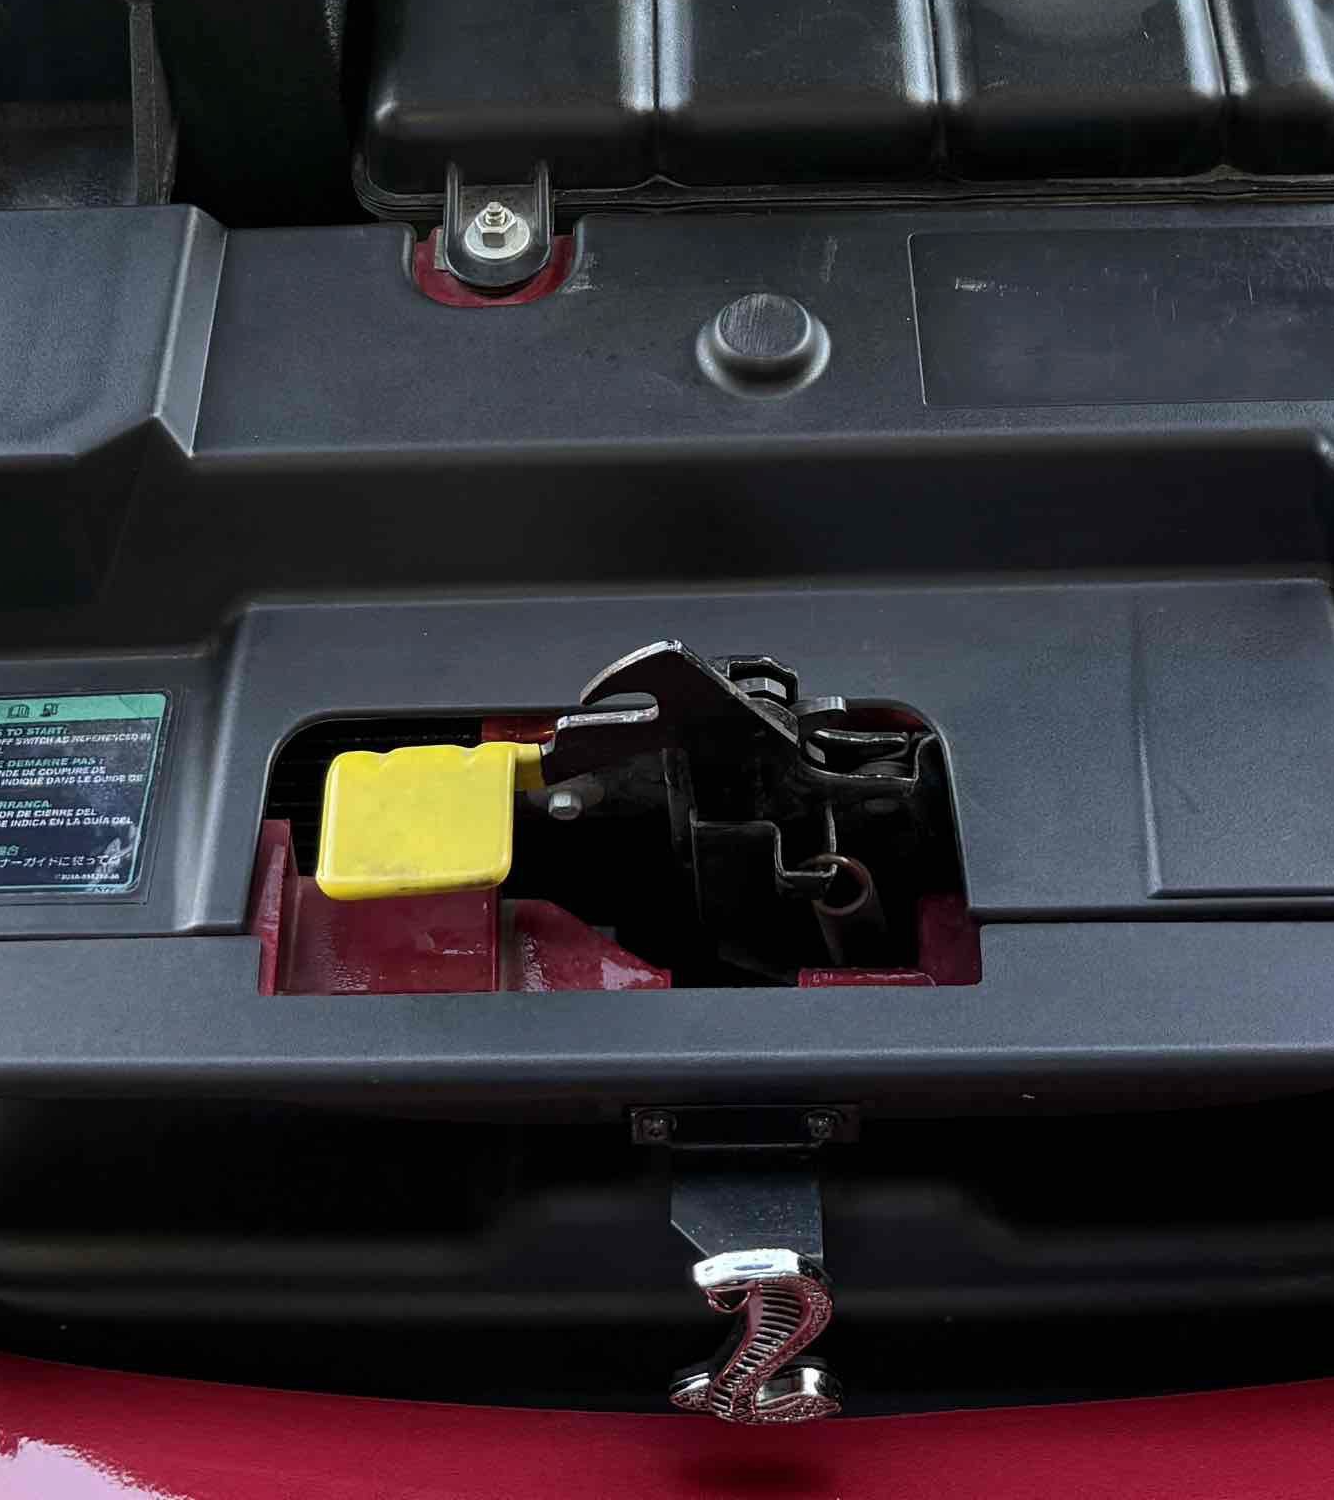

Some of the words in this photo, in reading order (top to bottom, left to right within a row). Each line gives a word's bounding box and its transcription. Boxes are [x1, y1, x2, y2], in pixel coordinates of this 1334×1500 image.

[7, 726, 22, 737] TO
[15, 736, 53, 746] SWITCH
[54, 736, 69, 744] AS
[22, 769, 36, 778] DE
[38, 767, 89, 777] COUPURE
[90, 766, 106, 775] DE
[47, 776, 76, 786] DANS
[77, 775, 91, 784] LE
[92, 774, 125, 784] GUIDE
[16, 810, 31, 819] DE
[34, 808, 73, 818] CIERRE
[76, 807, 96, 816] DEL
[10, 818, 47, 828] INDICA
[49, 817, 65, 826] EN
[66, 817, 80, 826] LA
[112, 815, 133, 824] DEL
